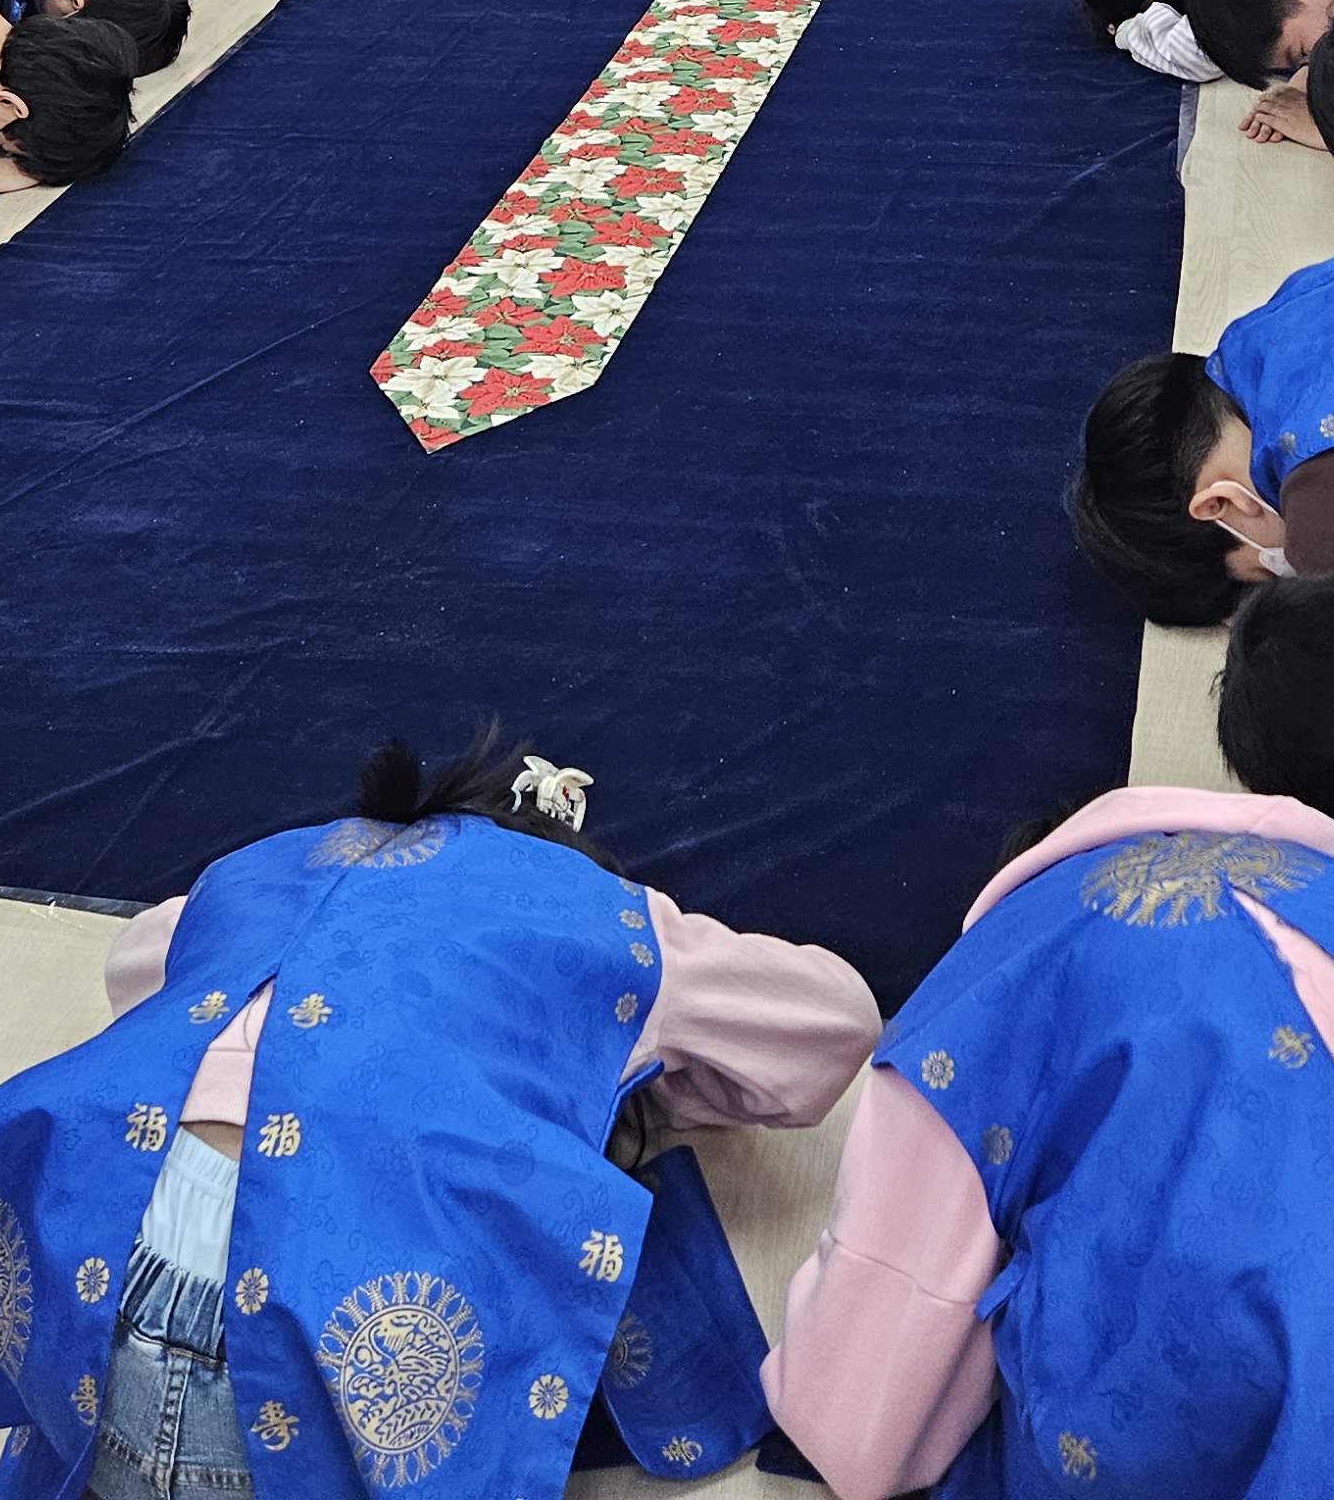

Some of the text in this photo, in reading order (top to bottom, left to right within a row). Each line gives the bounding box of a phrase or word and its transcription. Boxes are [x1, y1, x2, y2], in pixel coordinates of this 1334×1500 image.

[125, 1102, 167, 1152] 福
[257, 1112, 301, 1158] 福
[578, 1228, 624, 1283] 福
